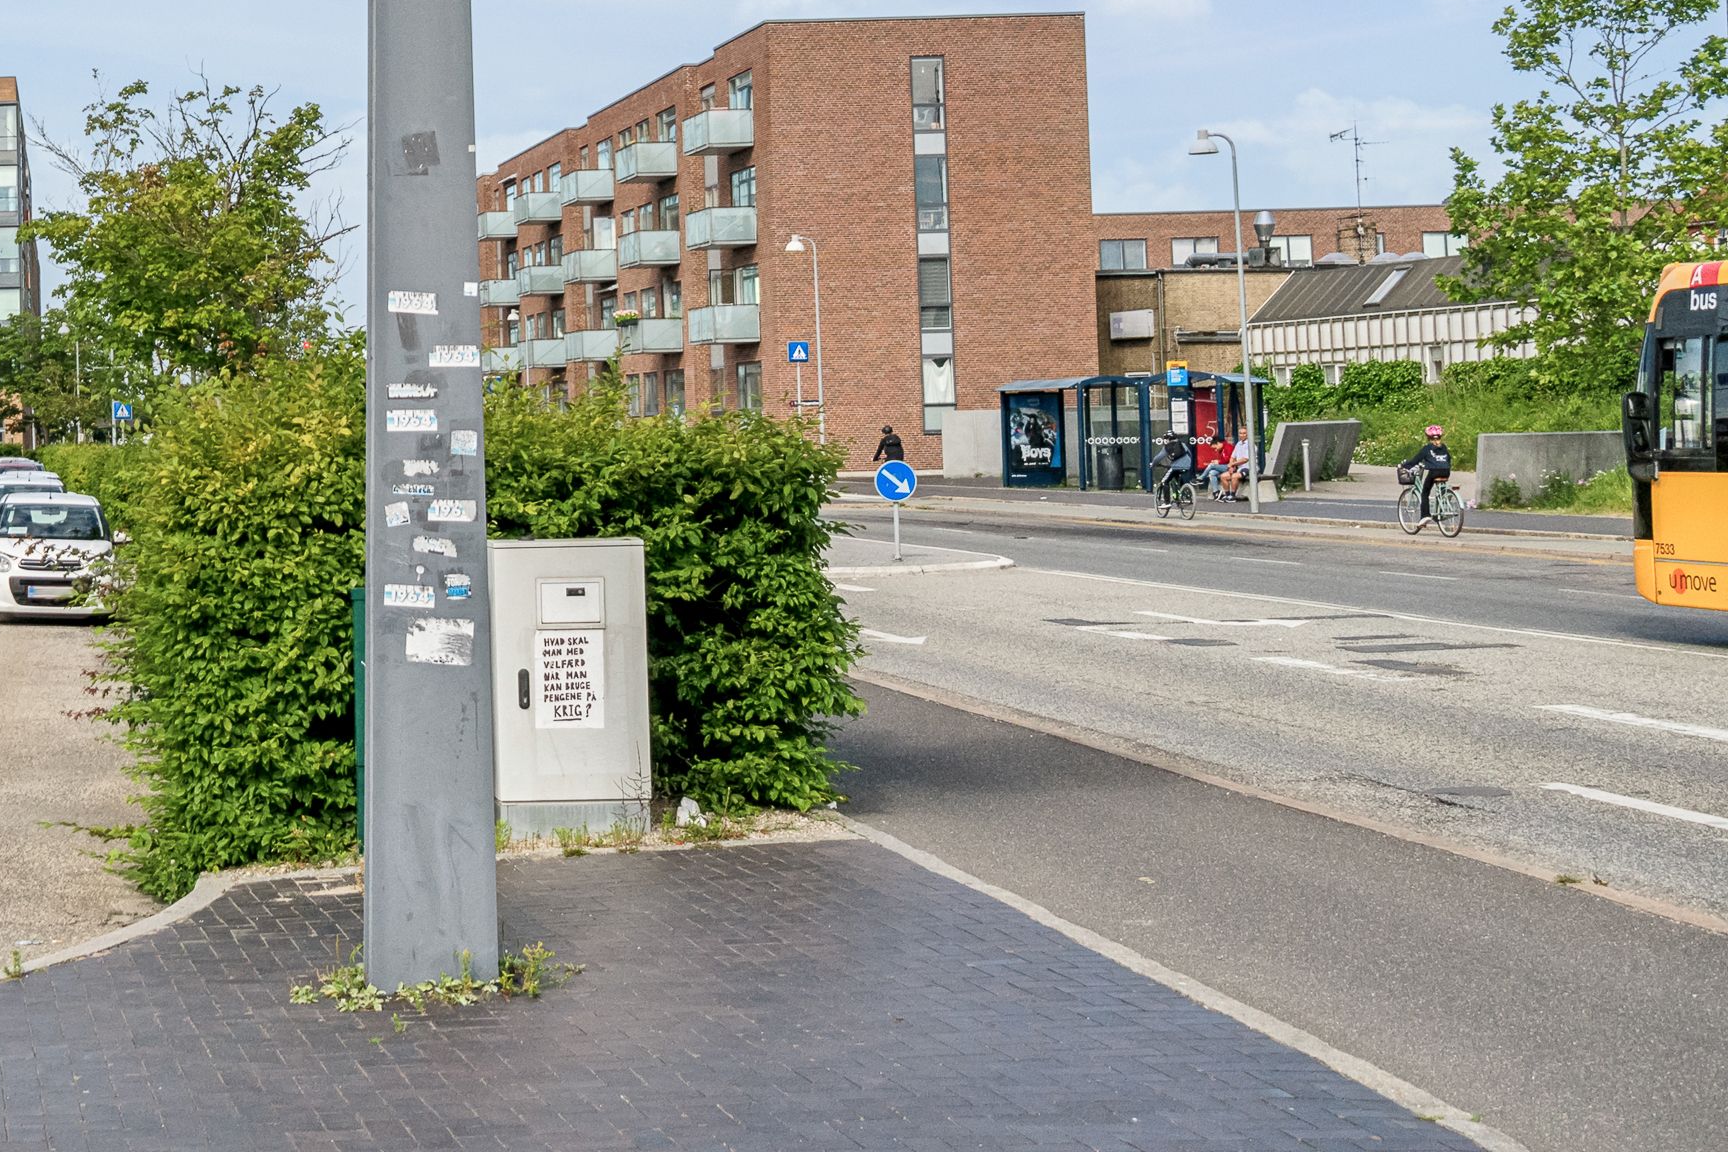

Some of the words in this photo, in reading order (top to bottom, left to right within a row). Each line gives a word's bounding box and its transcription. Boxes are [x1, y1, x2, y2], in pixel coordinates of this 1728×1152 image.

[1691, 264, 1703, 286] A
[395, 298, 434, 309] 1964
[1690, 290, 1717, 311] bus
[436, 351, 474, 363] 1964
[393, 415, 432, 427] 1964
[1655, 543, 1675, 555] 7533
[391, 590, 430, 602] 1964
[543, 638, 565, 647] HVAD
[567, 636, 589, 645] SKAL
[542, 648, 562, 657] MAN
[566, 648, 584, 656] MED
[543, 659, 586, 669] VELFÆRD
[543, 671, 560, 681] NÅR
[566, 670, 587, 680] MAN
[543, 683, 562, 692] KAN
[565, 681, 591, 691] BRUGE
[543, 692, 582, 702] PENGENE
[586, 691, 597, 702] PÅ
